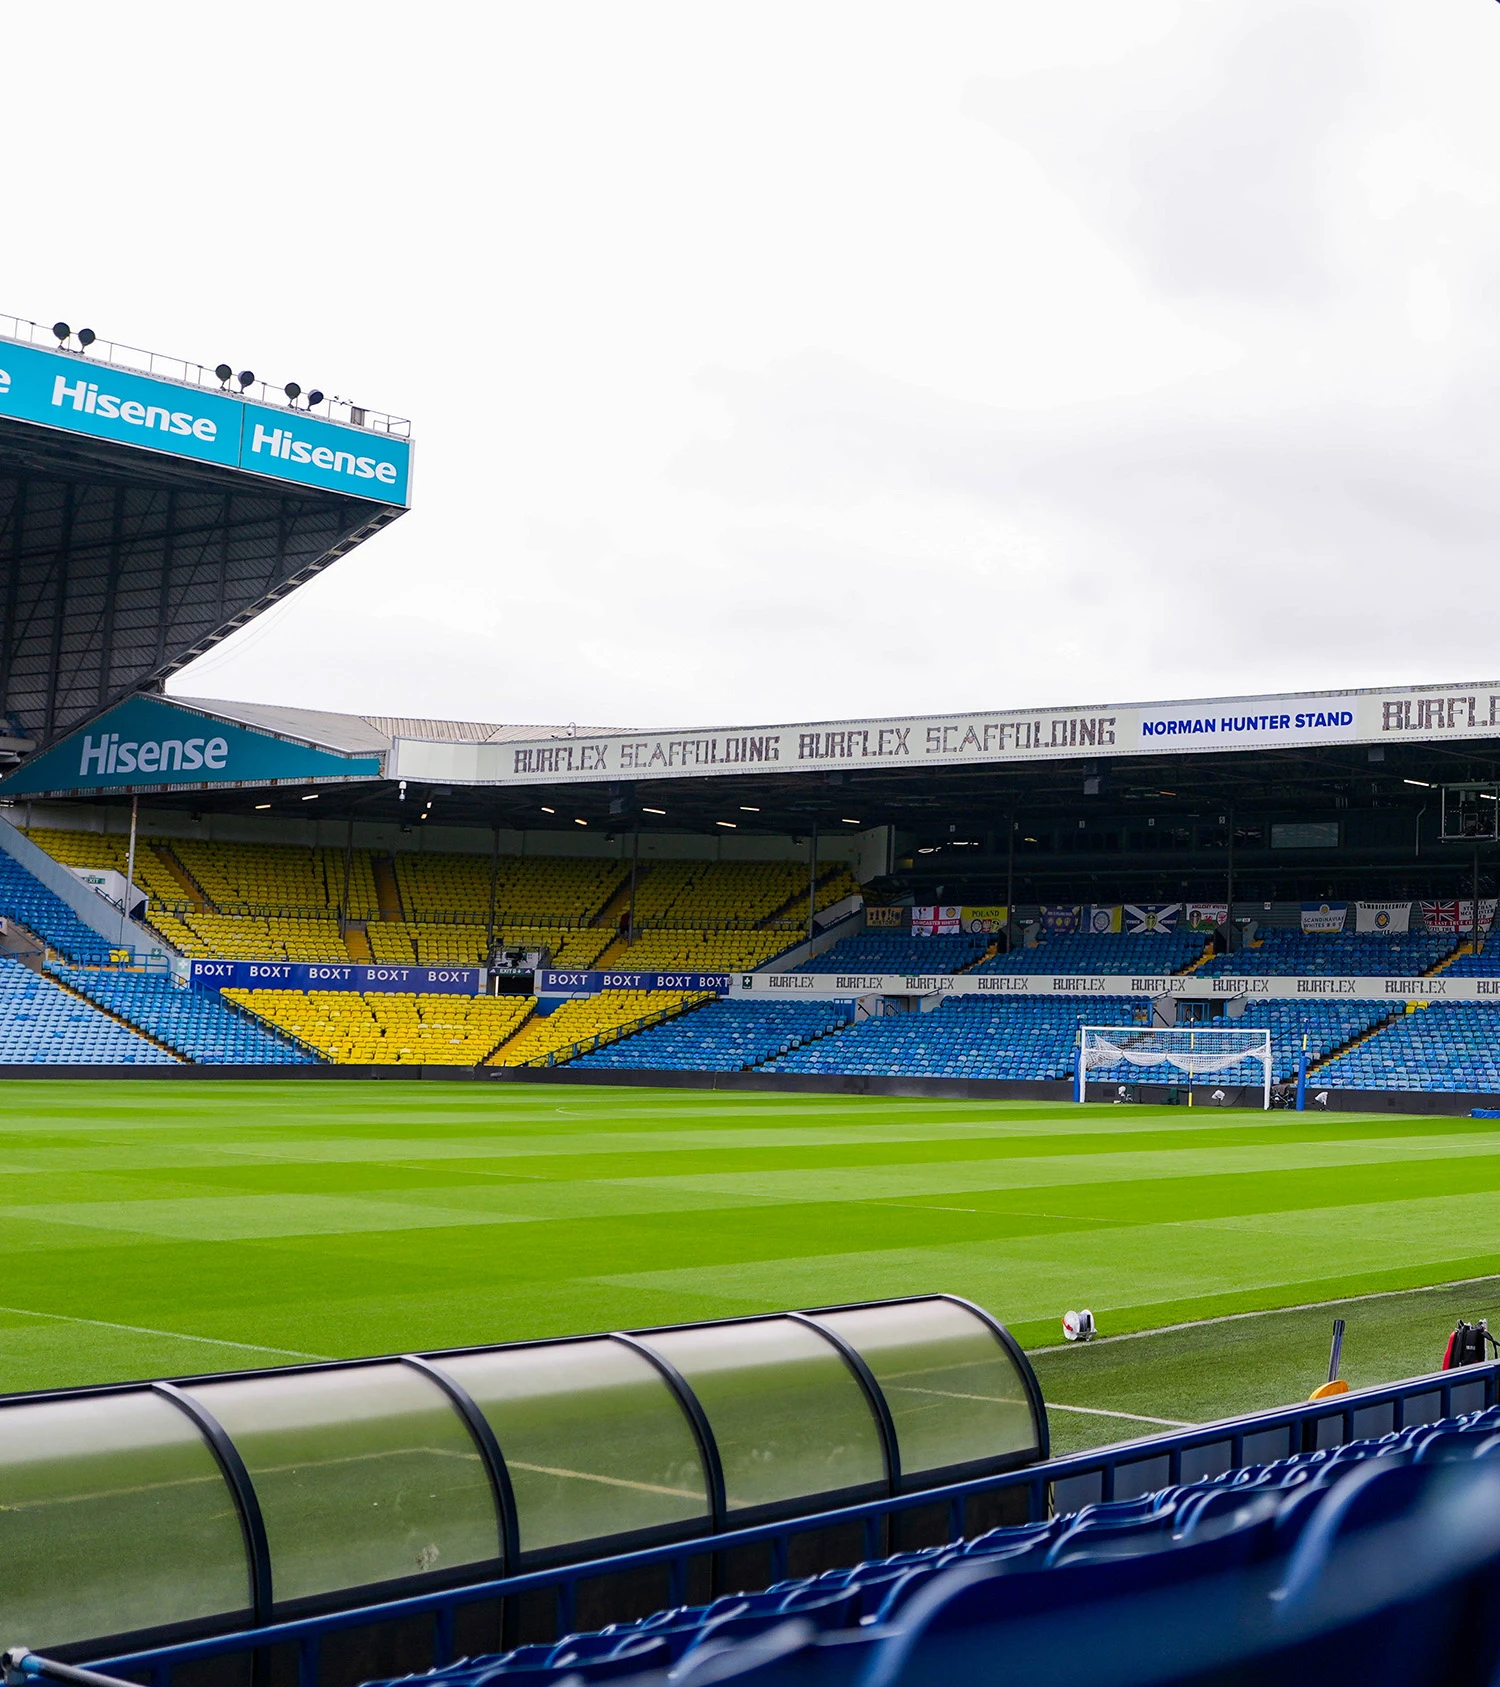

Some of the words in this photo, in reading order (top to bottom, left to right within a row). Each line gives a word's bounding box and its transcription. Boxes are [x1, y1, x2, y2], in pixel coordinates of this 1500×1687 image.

[51, 375, 217, 442] Hisense
[251, 424, 397, 485] Hisense
[799, 727, 911, 760] BURFLEX
[925, 717, 1116, 755] SCAFFOLDING
[1142, 718, 1217, 737] NORMAN
[1221, 715, 1291, 733] HUNTER
[1294, 711, 1354, 730] STAND
[79, 733, 228, 776] Hisense
[513, 744, 607, 775] BURFLEX
[620, 737, 780, 769] SCAFFOLDING
[195, 964, 234, 976] BOXT
[250, 966, 291, 978] BOXT
[310, 968, 351, 980] BOXT
[367, 969, 409, 981] BOXT
[428, 971, 470, 982] BOXT
[549, 974, 588, 985] BOXT
[603, 975, 640, 986] BOXT
[657, 976, 691, 987] BOXT
[700, 976, 730, 987] BOXT
[769, 976, 814, 988] BURFLEX
[836, 977, 883, 989] BURFLEX
[906, 977, 954, 990] BURFLEX
[978, 978, 1028, 990] BURFLEX
[1053, 978, 1105, 991] BURFLEX
[1131, 979, 1185, 991] BURFLEX
[1212, 979, 1268, 992] BURFLEX
[1297, 980, 1355, 993] BURFLEX
[1385, 980, 1446, 994] BURFLEX
